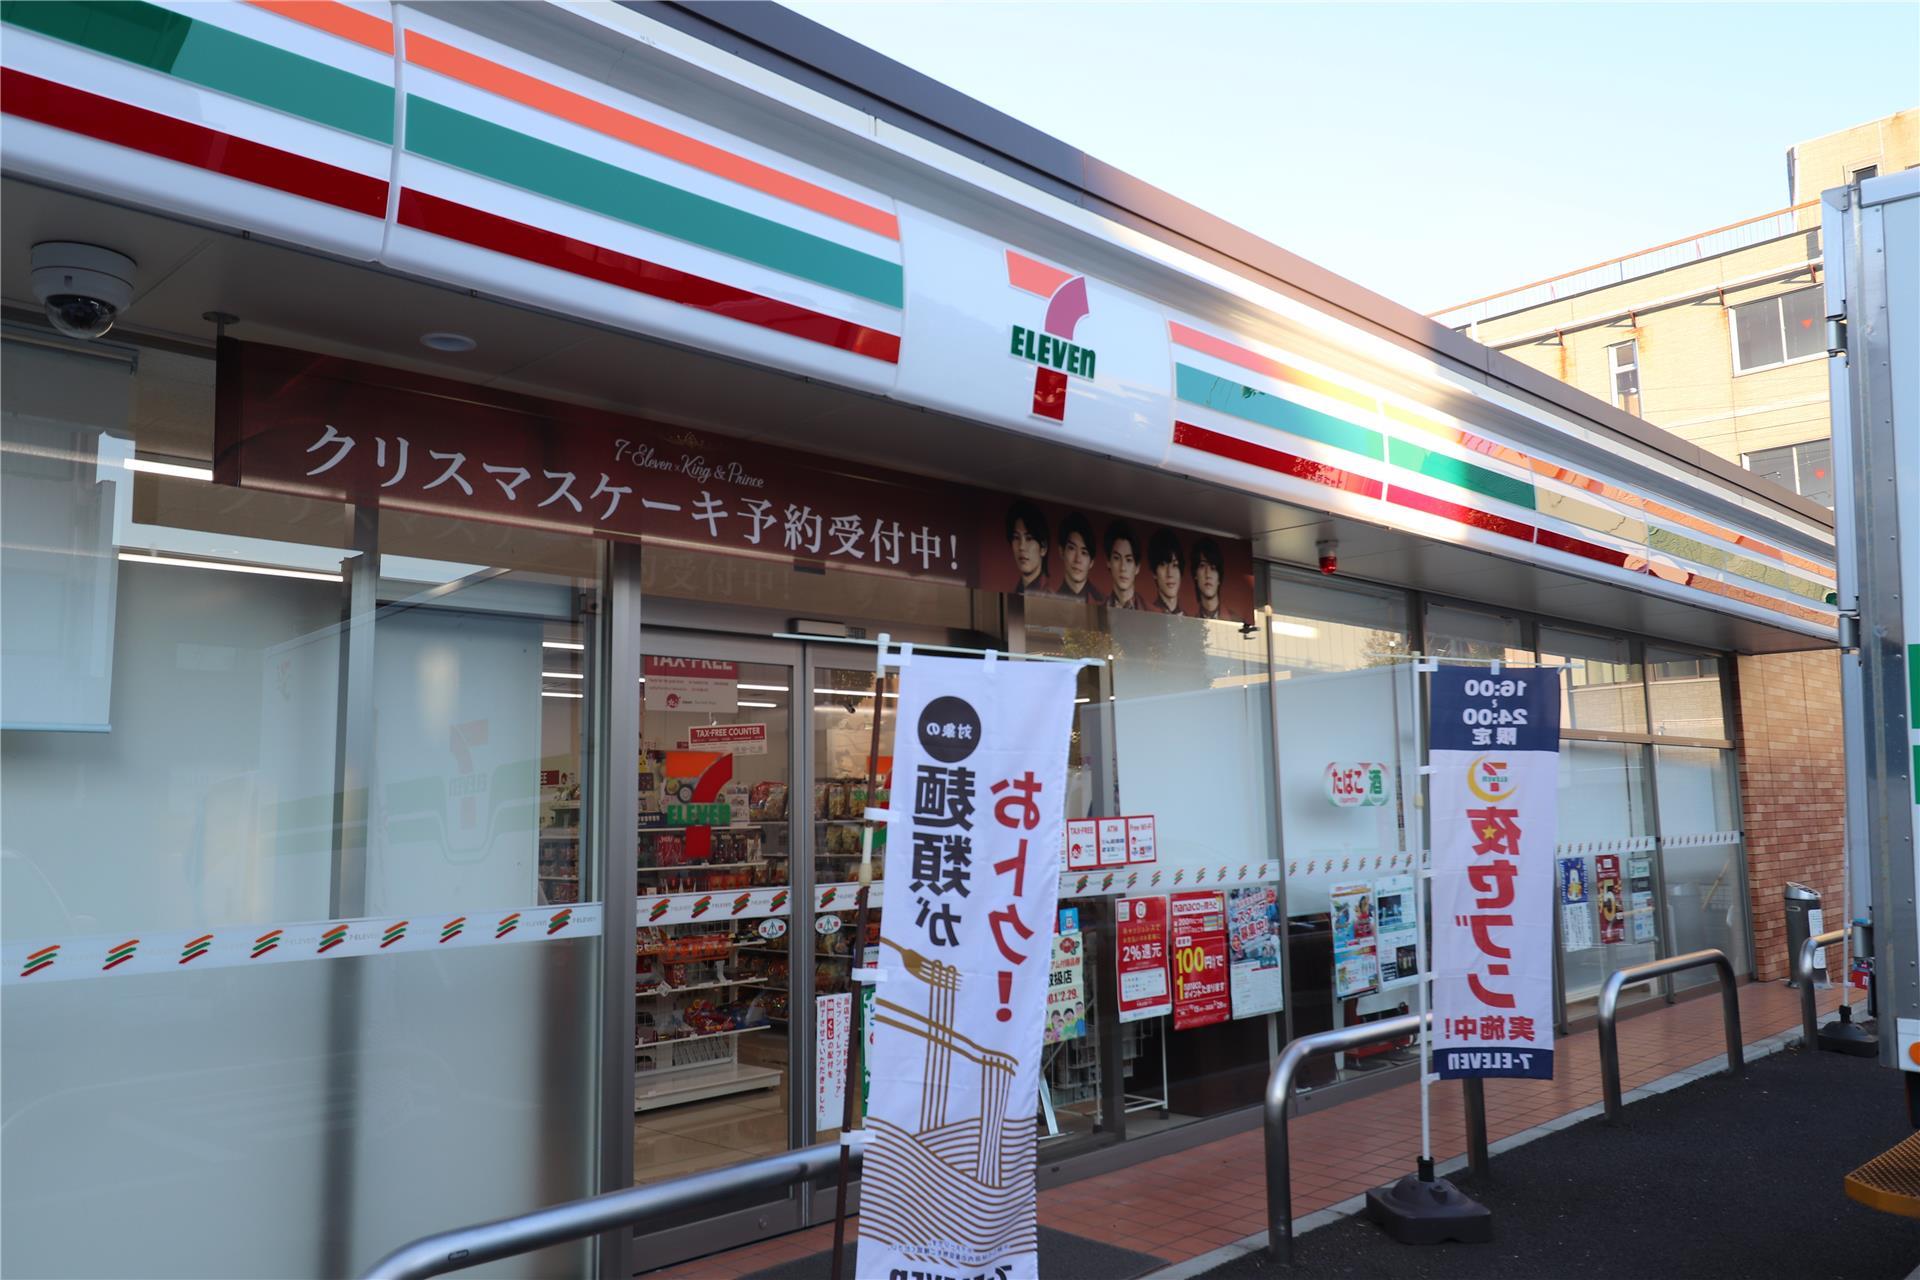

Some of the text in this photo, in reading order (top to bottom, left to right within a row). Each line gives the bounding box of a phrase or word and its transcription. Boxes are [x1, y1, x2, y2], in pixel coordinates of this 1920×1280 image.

[681, 454, 711, 484] King
[713, 464, 726, 481] &
[728, 461, 765, 489] Prince
[695, 726, 761, 738] TAX-FREE COUNTER
[1331, 768, 1383, 795] たばこ 酒
[1069, 825, 1095, 835] TAX-FREE
[1106, 824, 1119, 833] ATM
[1122, 942, 1163, 963] 2%還元
